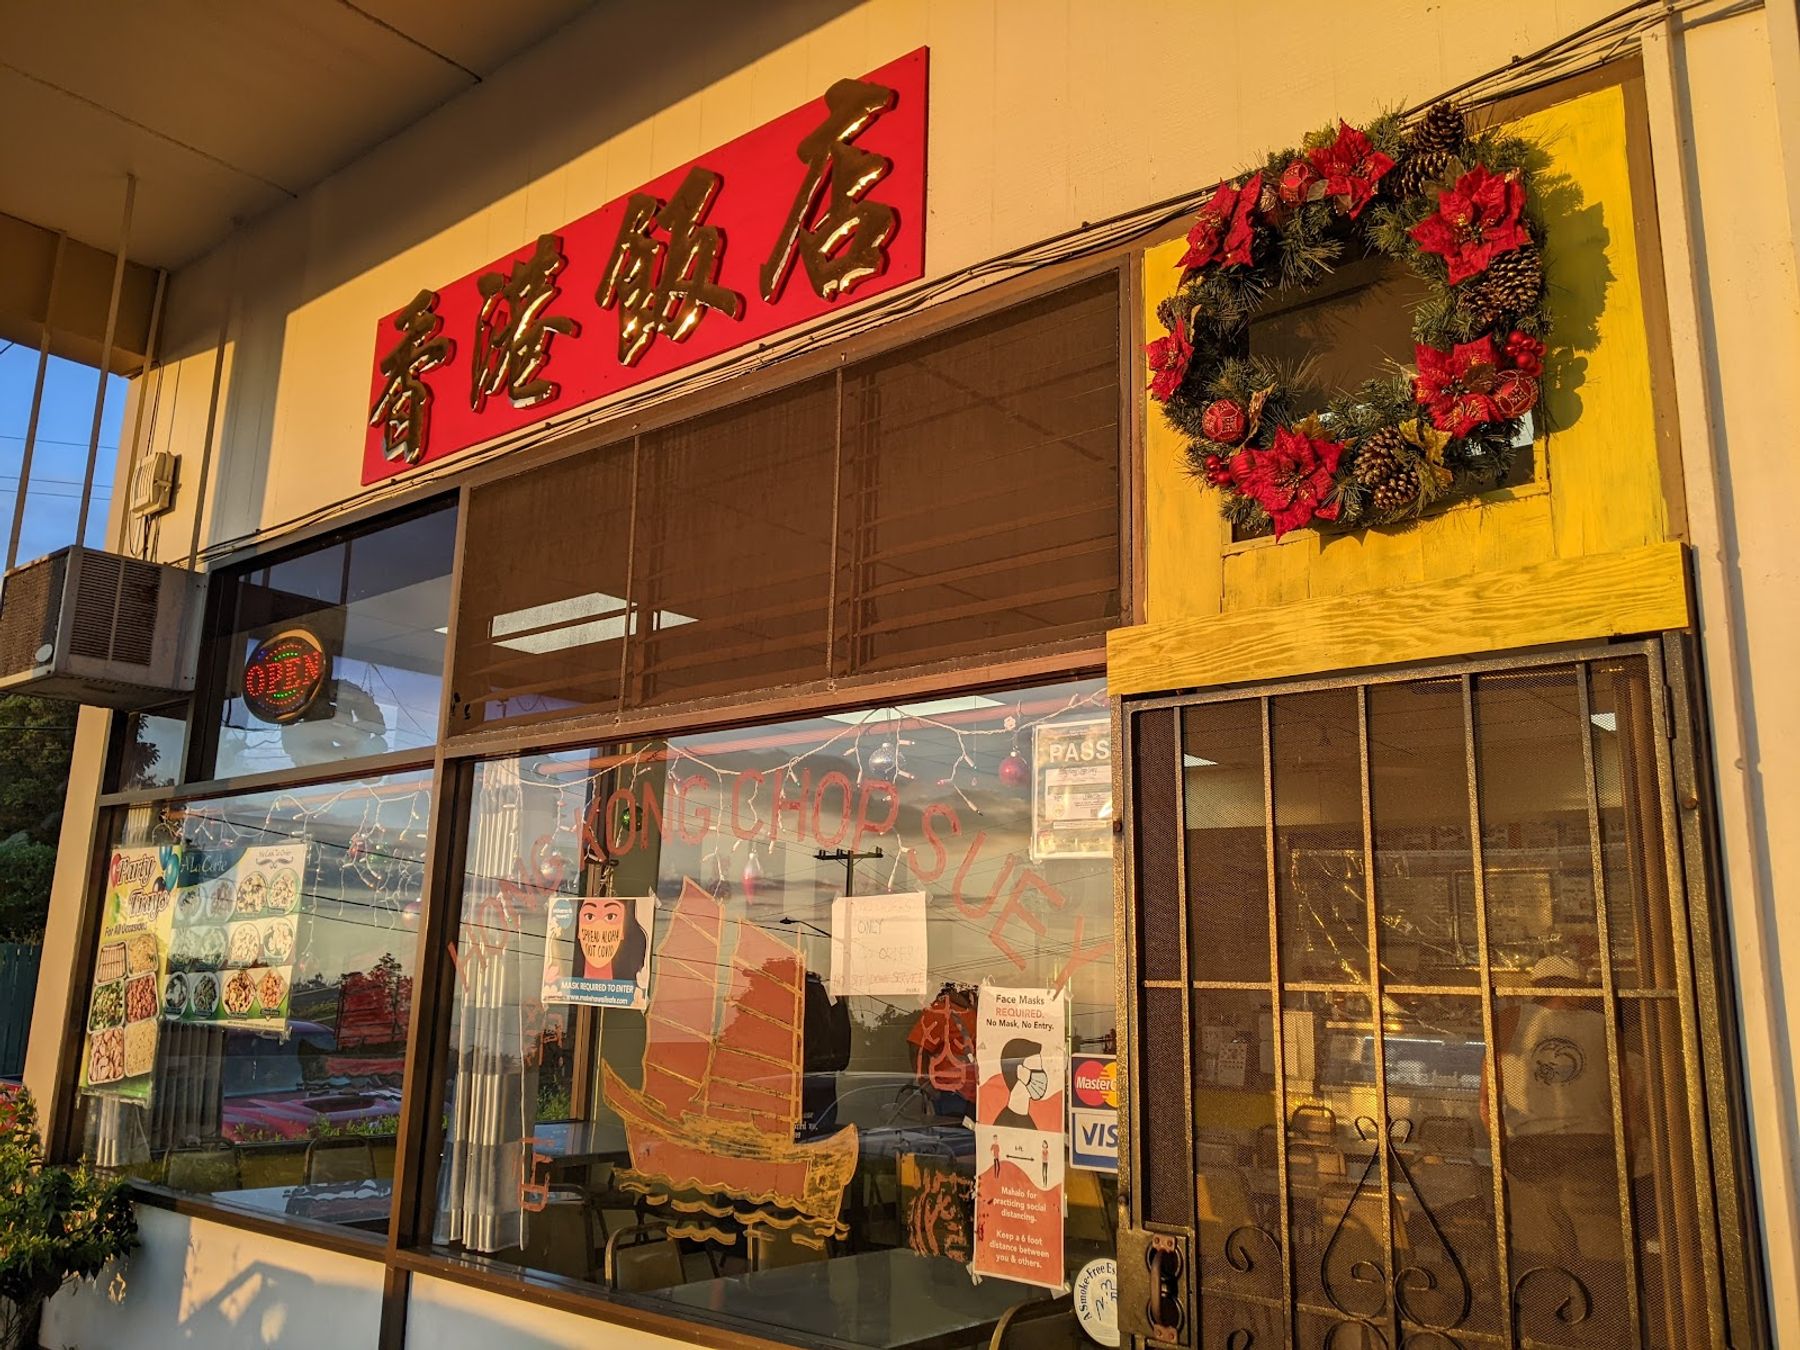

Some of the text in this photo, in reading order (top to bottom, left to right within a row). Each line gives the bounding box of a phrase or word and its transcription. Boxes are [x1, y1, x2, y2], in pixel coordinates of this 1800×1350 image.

[246, 651, 320, 697] OPEN
[1049, 740, 1110, 763] PASS
[117, 853, 156, 888] Party
[448, 764, 1113, 1002] HONG KONG CHOP SUEY
[128, 887, 170, 921] Trays
[581, 928, 600, 943] SPREAD
[561, 981, 634, 994] MASK REQUIRED TO ENTER
[995, 994, 1045, 1005] Face Masks
[995, 1007, 1044, 1019] REQUIRED.
[986, 1018, 1054, 1032] No Mask, No Entry.
[1001, 1186, 1037, 1199] Mahalo for
[992, 1197, 1047, 1212] practicing social
[1001, 1209, 1037, 1224] distancing.
[996, 1229, 1014, 1242] Keep
[1027, 1234, 1043, 1246] foot
[989, 1240, 1050, 1258] distance between
[995, 1254, 1009, 1263] you
[1018, 1256, 1042, 1268] others.
[1083, 1311, 1093, 1321] A
